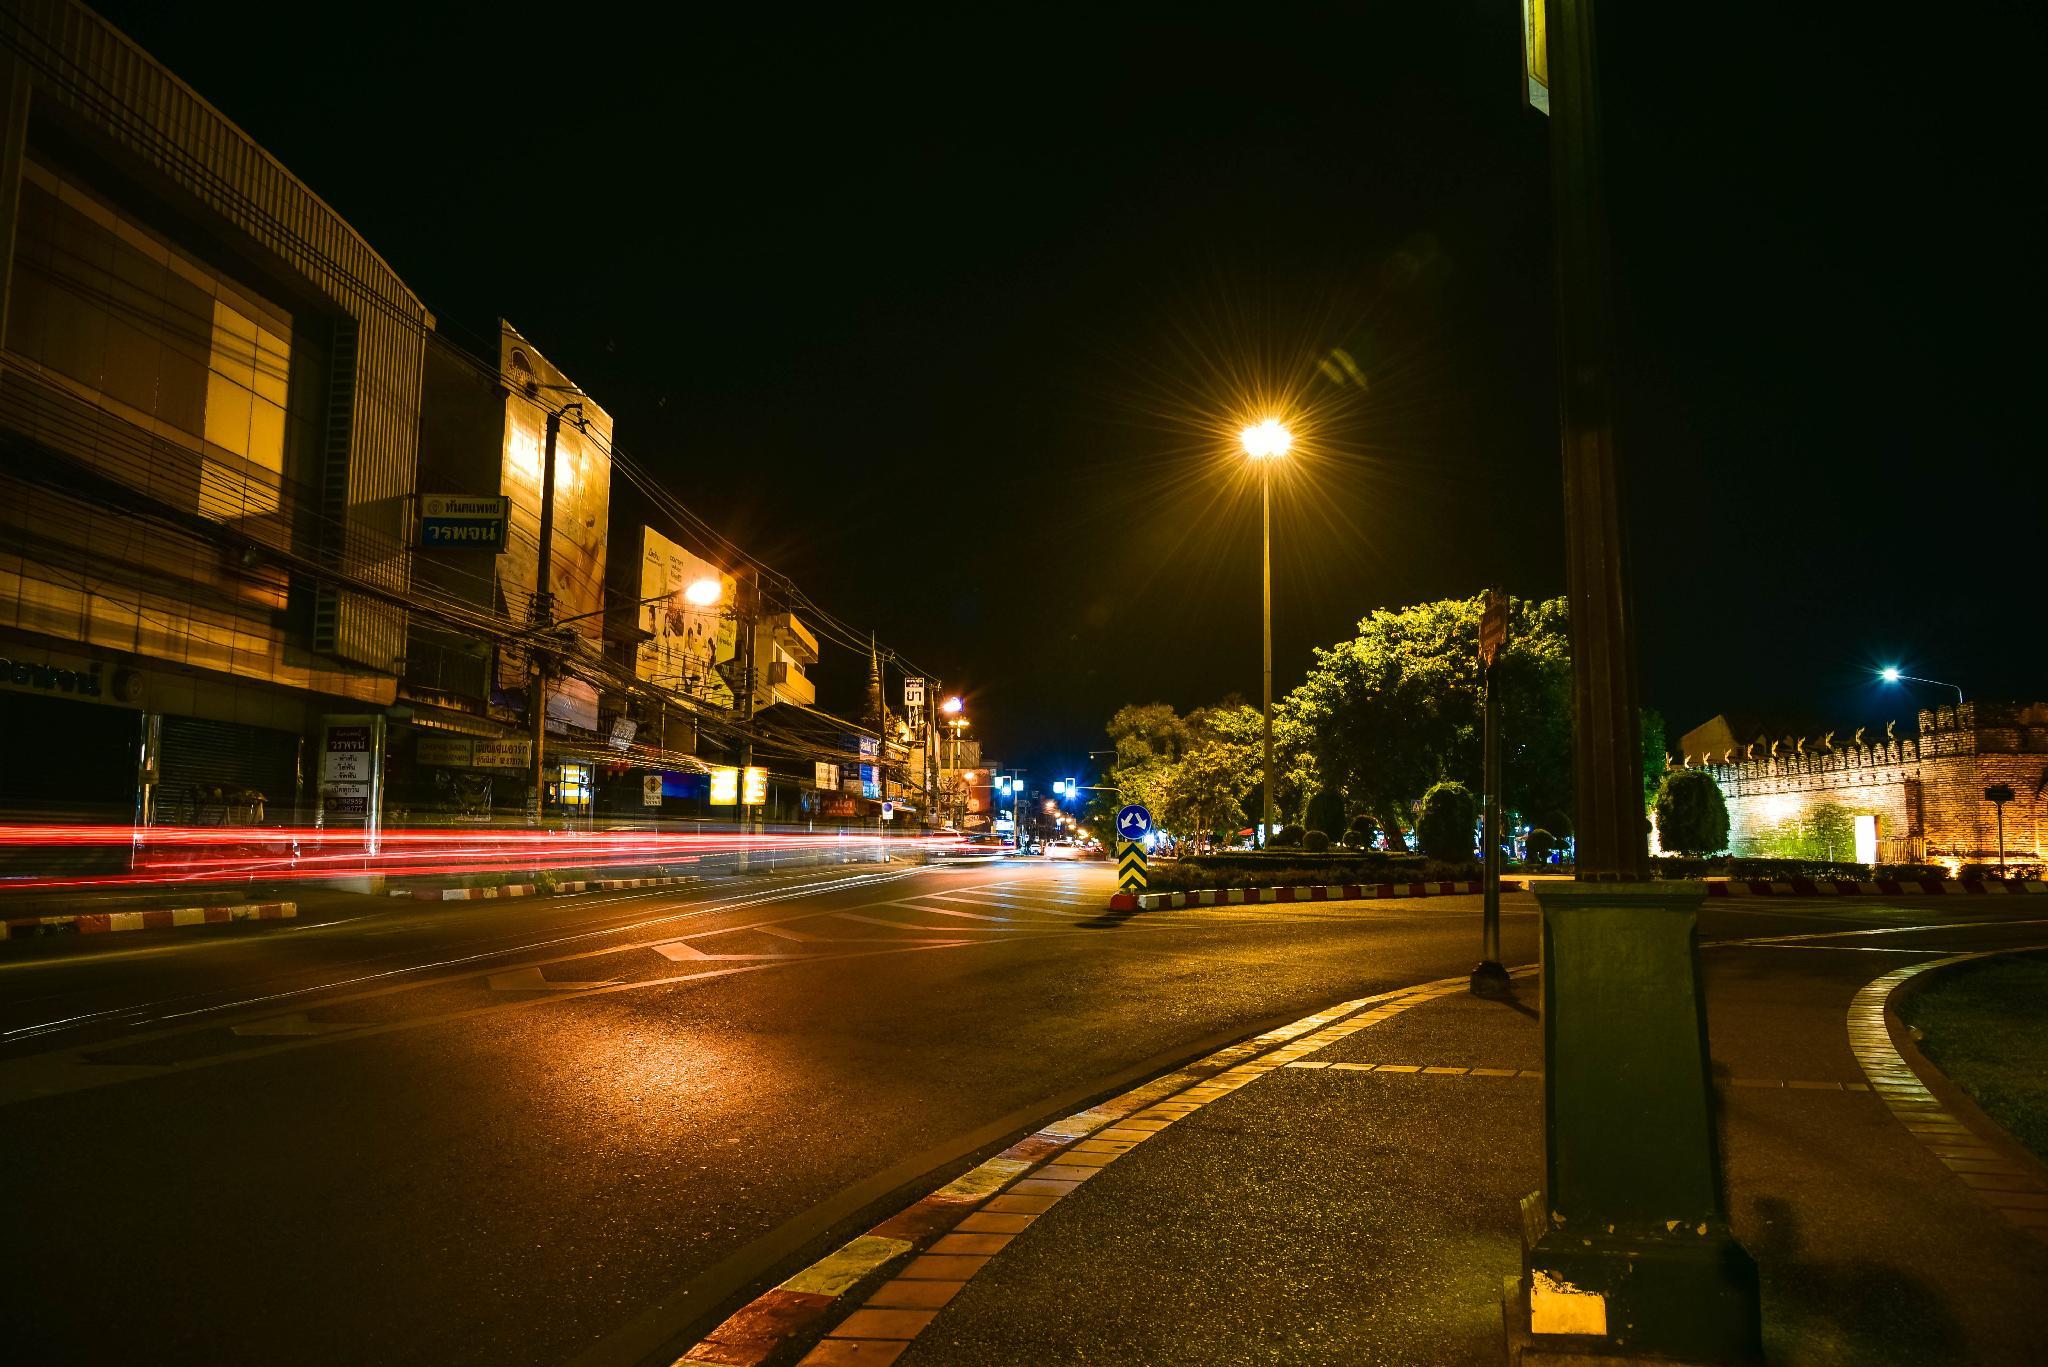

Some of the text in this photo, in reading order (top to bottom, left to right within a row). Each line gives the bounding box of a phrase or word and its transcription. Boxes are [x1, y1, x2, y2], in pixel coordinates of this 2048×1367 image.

[445, 498, 500, 514] ทันตแพทย์
[428, 520, 499, 541] วรพจน์
[906, 690, 922, 702] ยา
[330, 736, 367, 750] วรพจน์
[331, 784, 360, 796] เปิดทุกวัน
